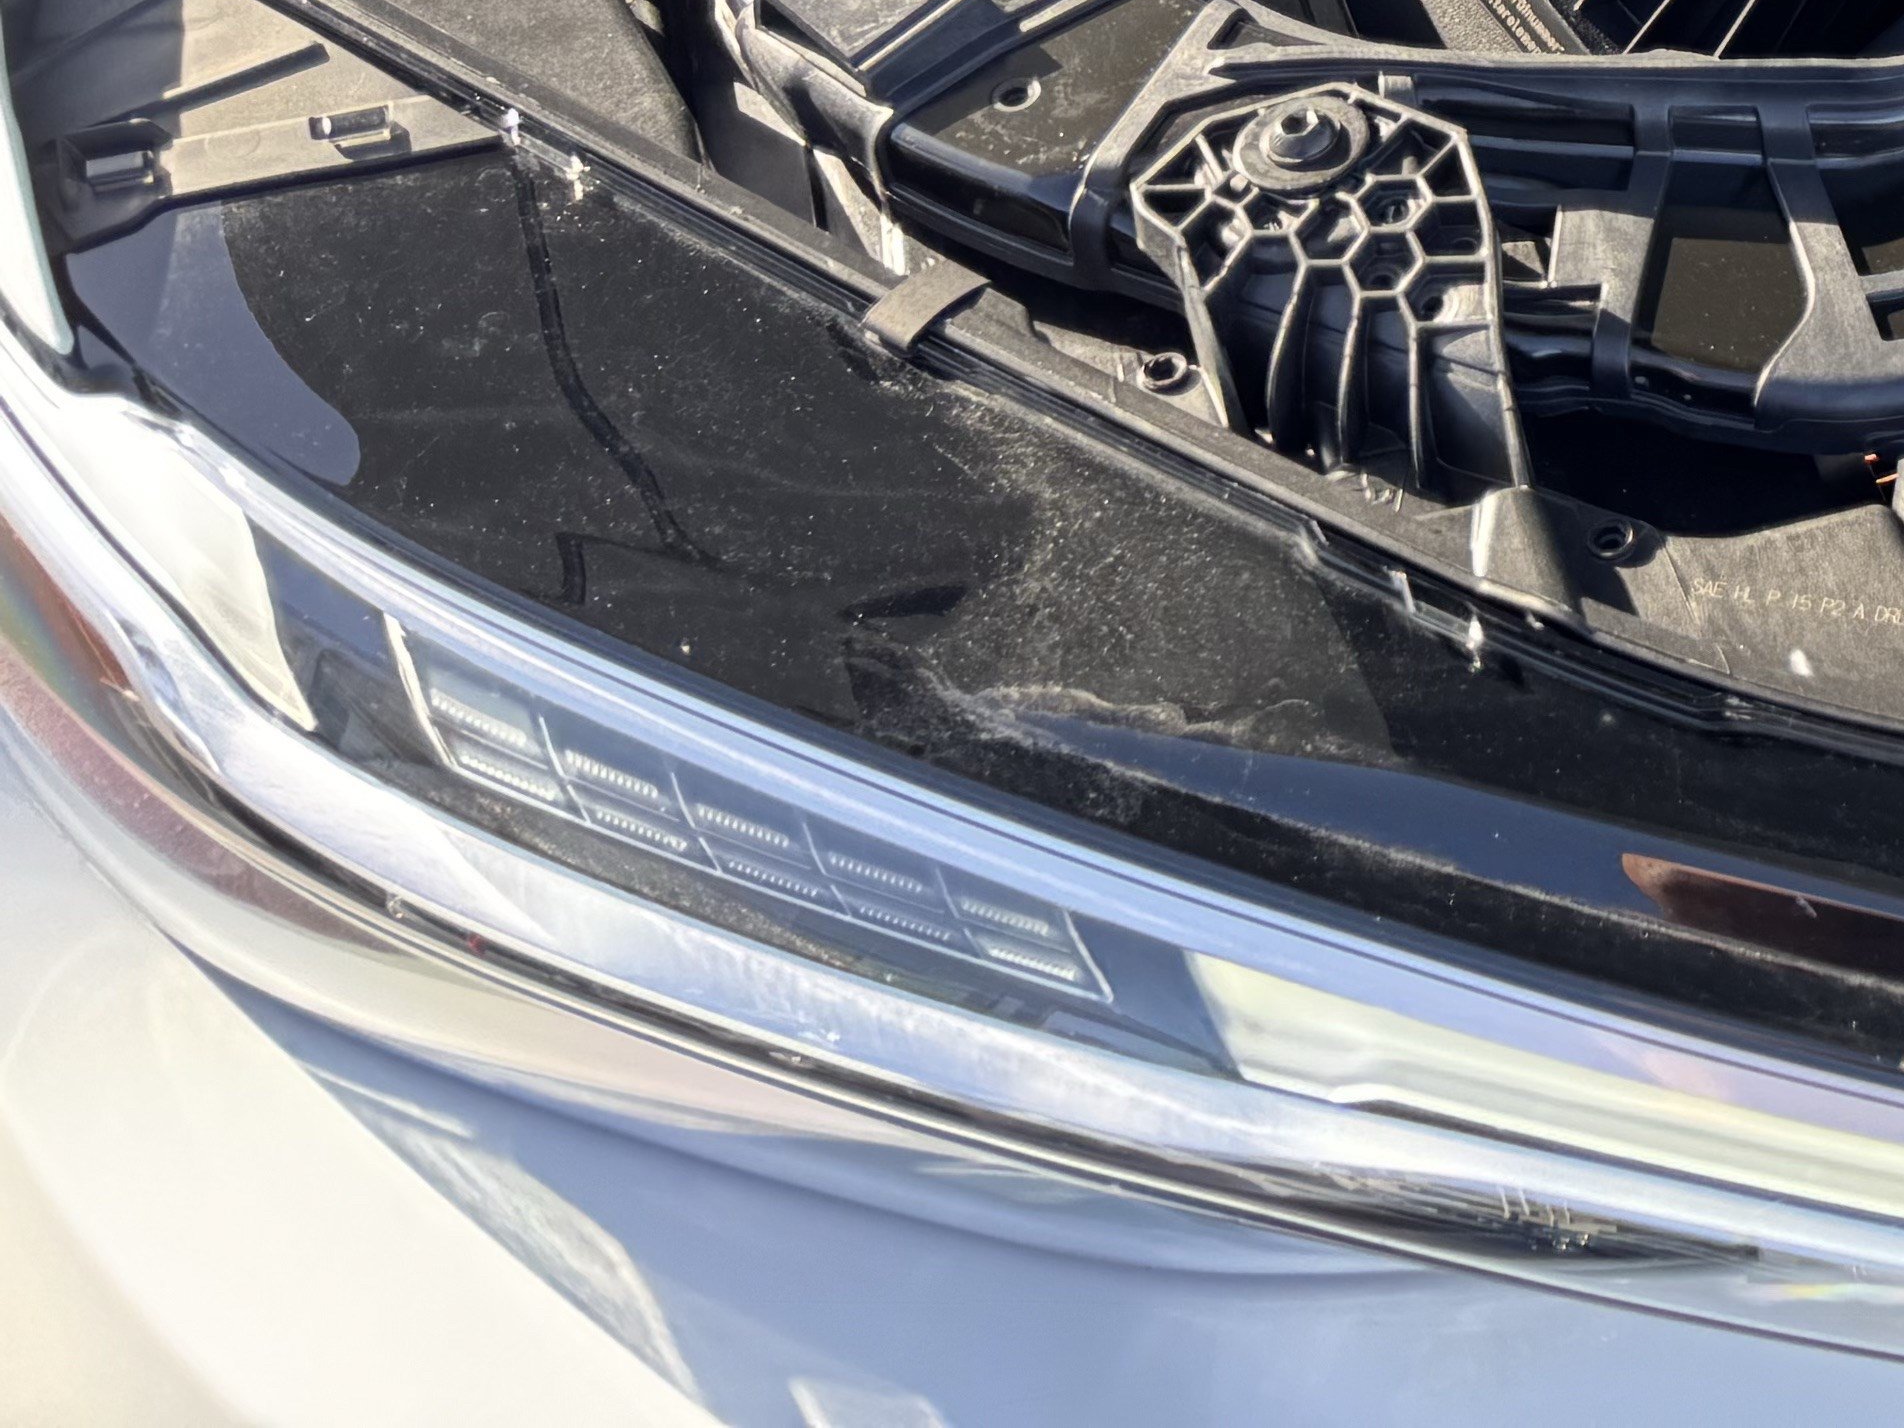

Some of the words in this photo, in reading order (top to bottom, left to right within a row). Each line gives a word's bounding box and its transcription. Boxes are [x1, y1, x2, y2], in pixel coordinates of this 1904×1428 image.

[1689, 575, 1728, 598] SAE
[1732, 583, 1758, 603] HL
[1765, 588, 1781, 607] P
[1852, 601, 1867, 619] A
